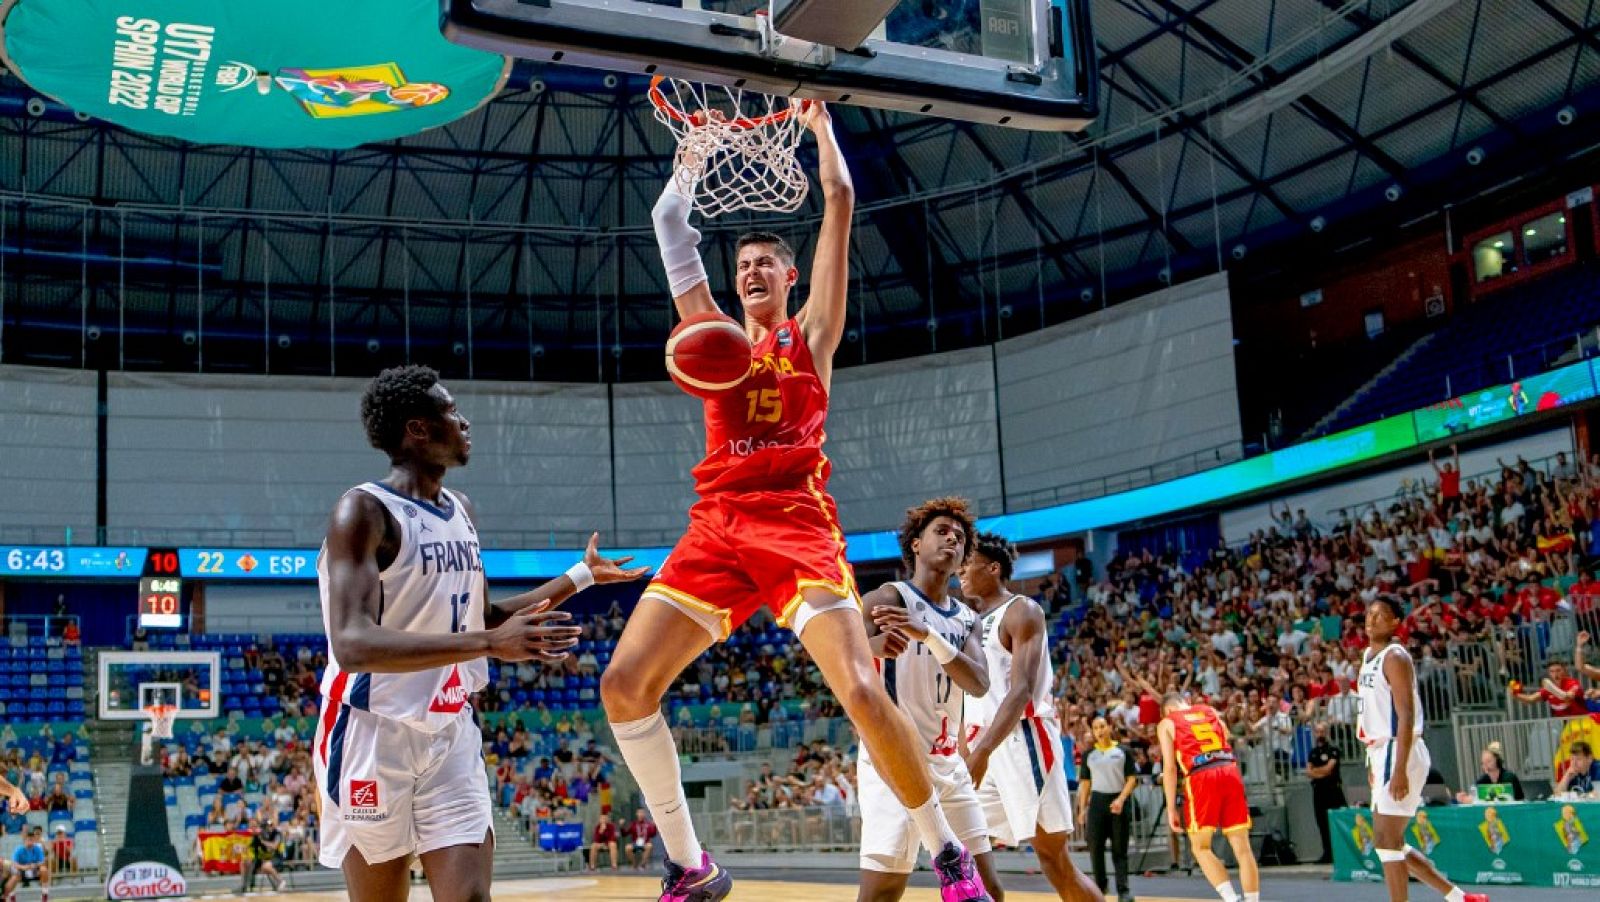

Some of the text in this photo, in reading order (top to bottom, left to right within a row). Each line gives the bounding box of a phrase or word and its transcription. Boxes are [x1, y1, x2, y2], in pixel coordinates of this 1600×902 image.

[163, 22, 215, 61] U17
[108, 16, 160, 110] SPAIN 2022
[153, 59, 189, 116] WORLD CUP
[745, 388, 783, 424] 15
[7, 548, 65, 571] 6:43
[151, 552, 178, 573] 10
[196, 551, 224, 573] 22
[269, 556, 306, 574] ESP
[147, 595, 176, 615] 10
[1190, 723, 1223, 753] 5
